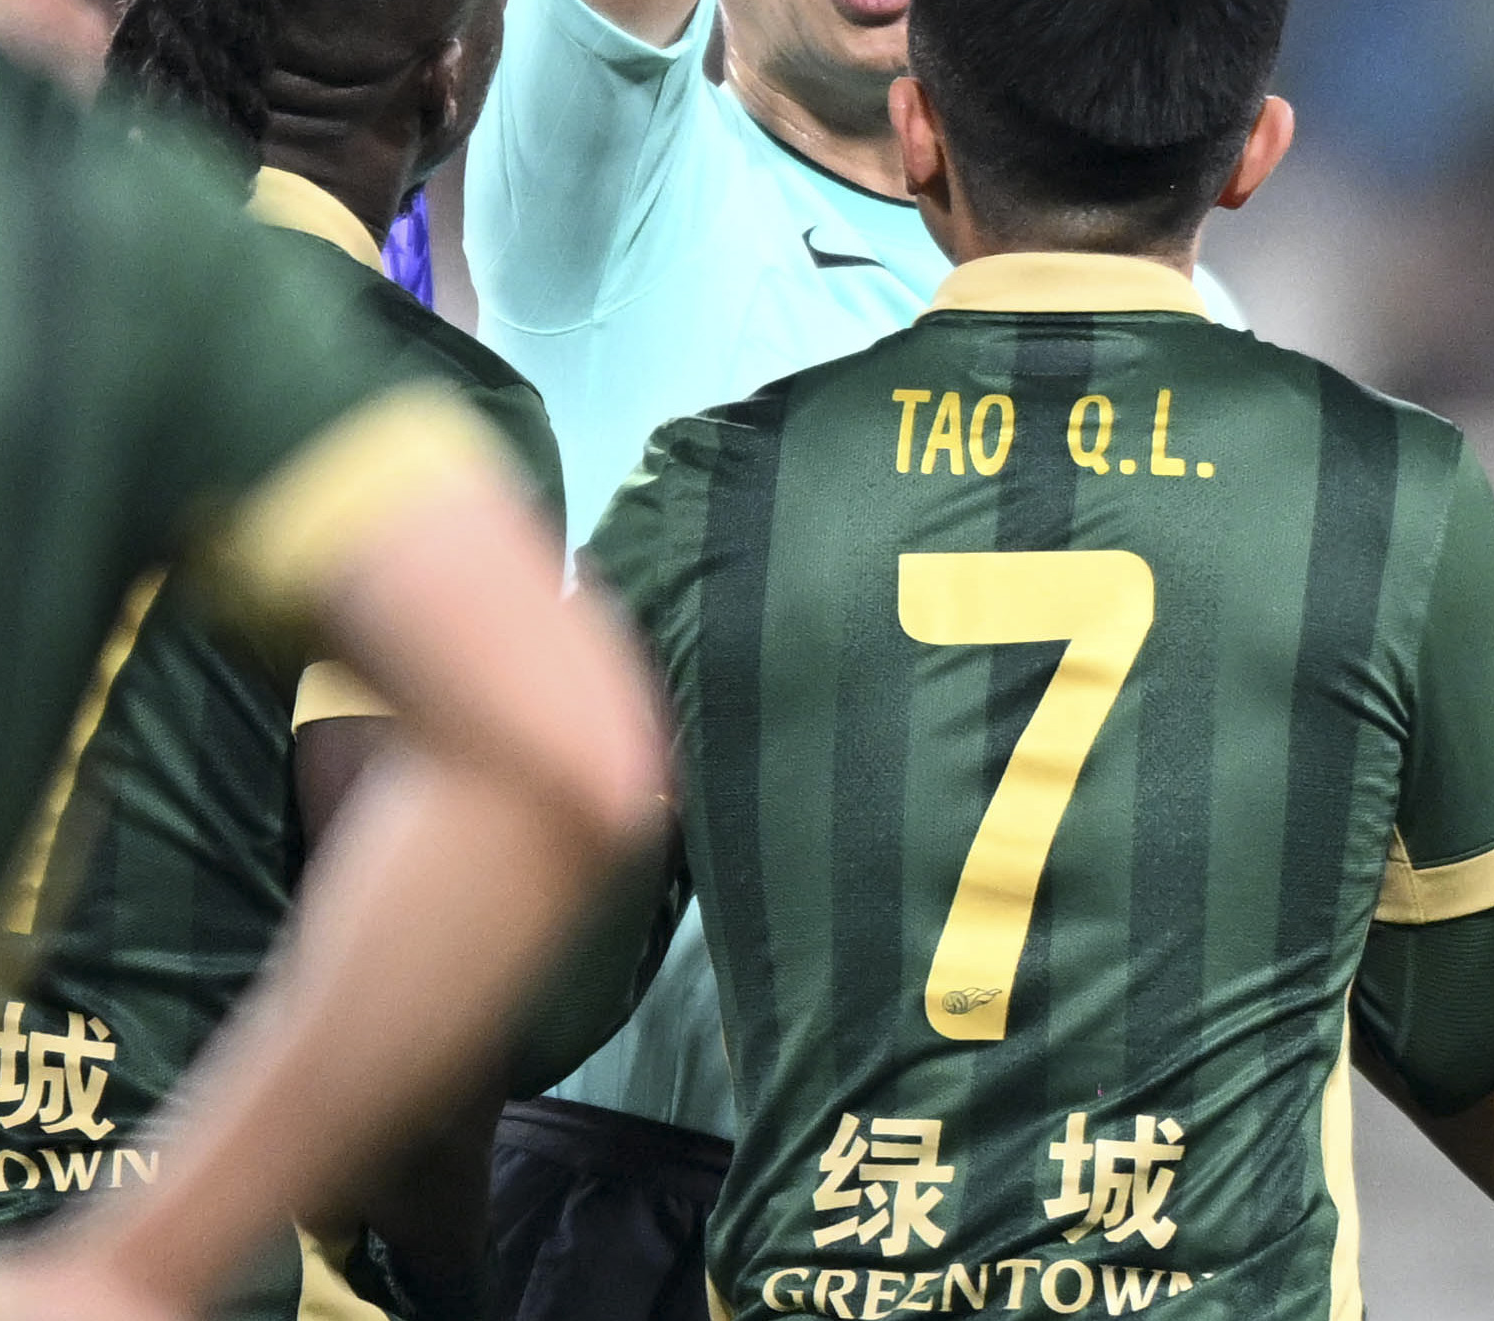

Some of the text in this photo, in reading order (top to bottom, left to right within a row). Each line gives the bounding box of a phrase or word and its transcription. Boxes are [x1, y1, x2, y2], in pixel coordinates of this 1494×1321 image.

[892, 389, 1215, 478] TAO Q.L.
[898, 550, 1154, 1041] 7
[813, 1112, 1186, 1257] 绿城
